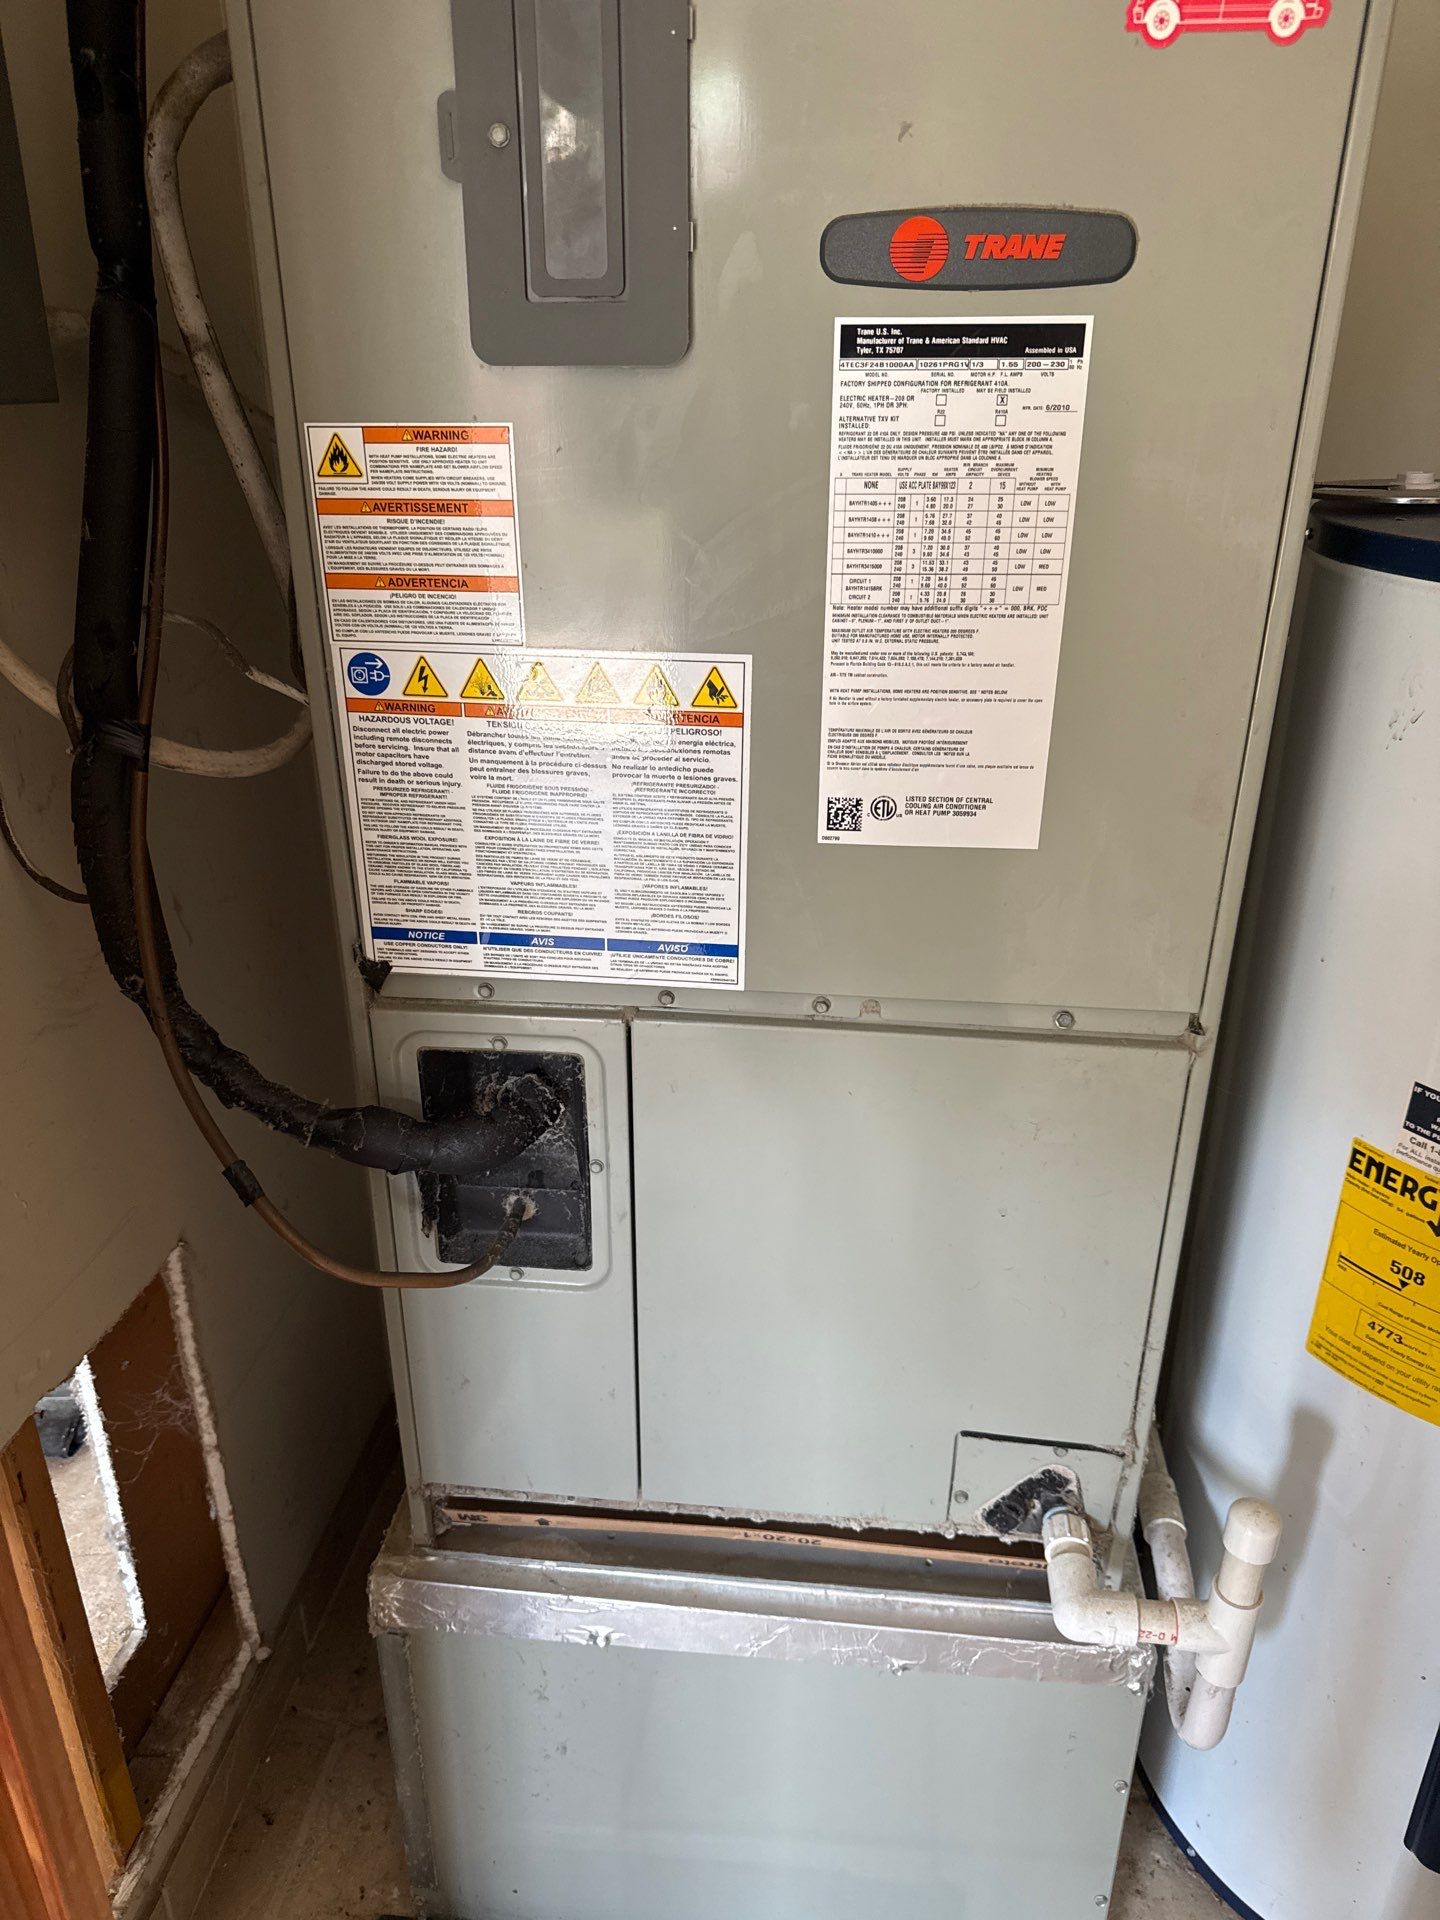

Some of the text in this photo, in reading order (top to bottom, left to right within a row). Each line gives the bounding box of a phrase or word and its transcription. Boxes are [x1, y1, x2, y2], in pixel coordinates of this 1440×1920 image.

[964, 226, 1066, 260] TRANE
[856, 346, 874, 355] Tyler,
[412, 430, 469, 440] WARNING
[864, 481, 878, 489] NONE
[968, 481, 973, 489] 2
[372, 502, 468, 512] AVERTISSEMENT
[388, 577, 469, 588] ADVERTENCIA
[385, 702, 435, 712] WARNING
[358, 715, 454, 726] HAZARDOUS VOLTAGE!
[353, 734, 385, 742] including
[408, 930, 445, 940] NOTICE
[530, 937, 554, 945] AVIS
[657, 943, 688, 952] AVISO
[1405, 1121, 1431, 1136] TO THE
[1410, 1137, 1428, 1150] Call
[1349, 1147, 1440, 1211] ENERG
[1373, 1228, 1430, 1261] Estimated Yearly
[1390, 1260, 1426, 1286] 508
[1368, 1321, 1403, 1344] 4773
